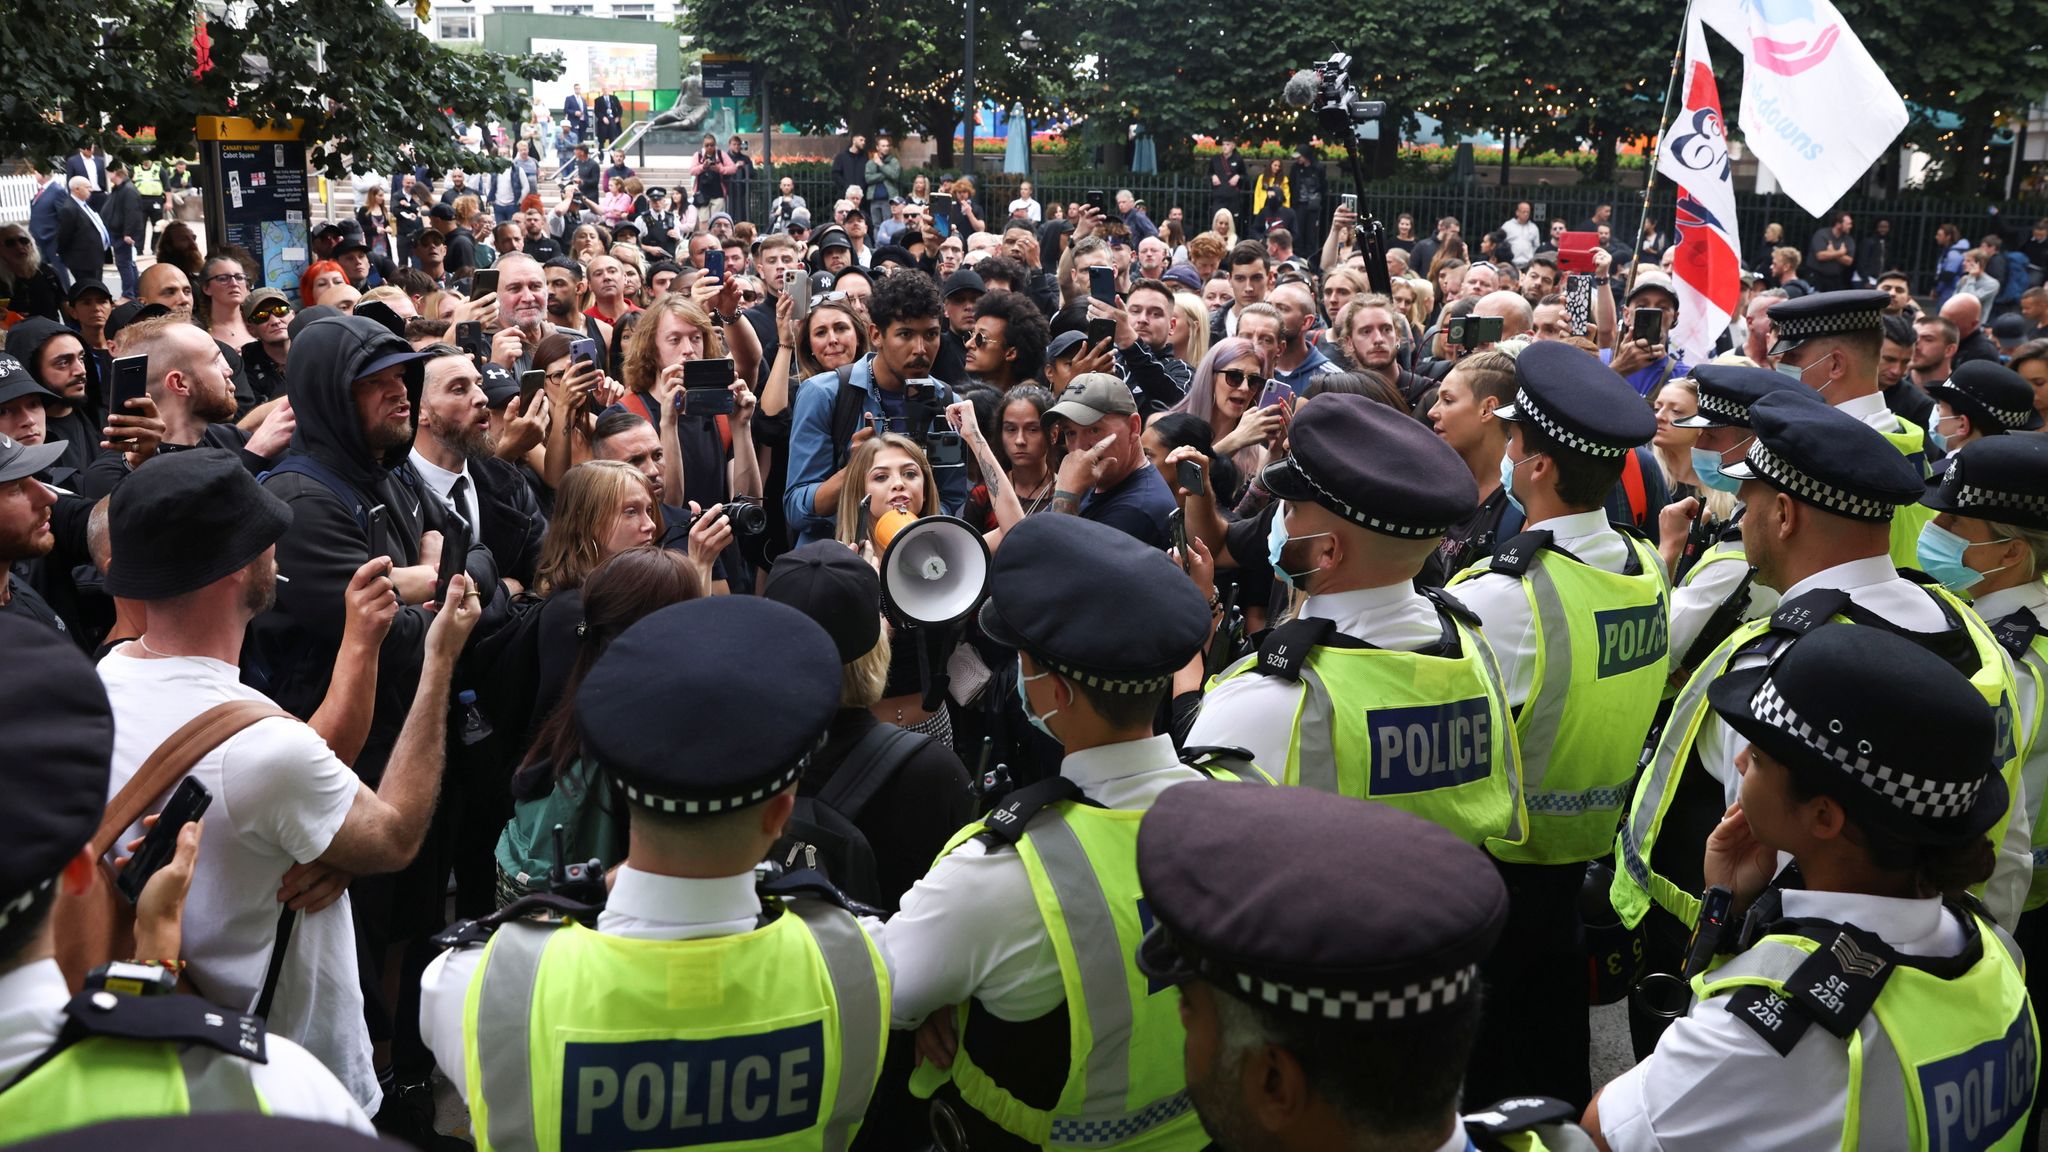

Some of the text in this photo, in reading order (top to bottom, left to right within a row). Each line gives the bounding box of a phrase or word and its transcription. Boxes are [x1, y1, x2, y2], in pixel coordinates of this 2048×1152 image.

[1498, 554, 1519, 565] 5403
[1509, 547, 1518, 555] U
[1778, 612, 1812, 629] 4171
[1792, 606, 1812, 618] SE
[1278, 644, 1287, 655] U
[1266, 653, 1289, 670] 5291
[1378, 713, 1489, 779] POLICE
[1009, 801, 1021, 812] U
[1826, 974, 1850, 997] SE
[1765, 991, 1789, 1015] SE
[1808, 982, 1846, 1015] 2291
[1747, 1000, 1783, 1032] 2291
[576, 1046, 812, 1135] POLICE
